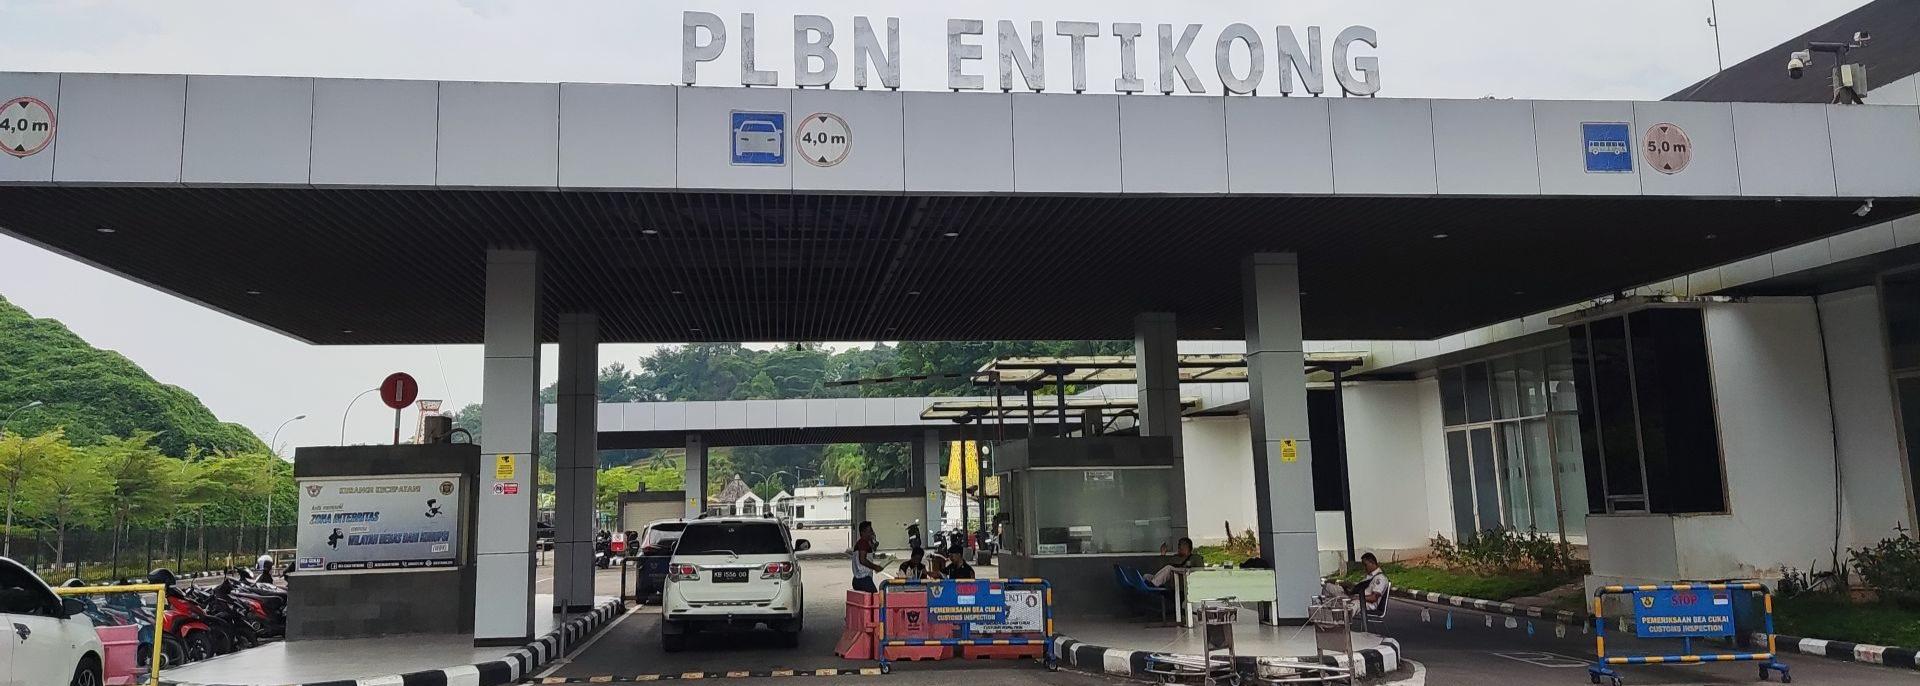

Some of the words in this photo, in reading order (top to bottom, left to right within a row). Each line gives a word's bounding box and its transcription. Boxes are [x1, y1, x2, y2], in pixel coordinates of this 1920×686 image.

[682, 11, 901, 88] PLBN
[947, 18, 1381, 96] ENTIKONG
[0, 118, 28, 133] 4,0
[32, 121, 49, 131] m
[802, 132, 828, 146] 4,0
[831, 135, 845, 144] m
[1648, 141, 1670, 154] 5,0
[1673, 144, 1686, 153] m
[309, 513, 332, 524] ZONA
[1671, 593, 1698, 606] STOP
[984, 605, 1003, 613] CUKAI
[1641, 616, 1692, 624] PEMERIKSAAN
[1708, 615, 1729, 623] CUKAI
[1649, 625, 1681, 633] CUSTOMS
[1682, 624, 1723, 632] INSPECTION
